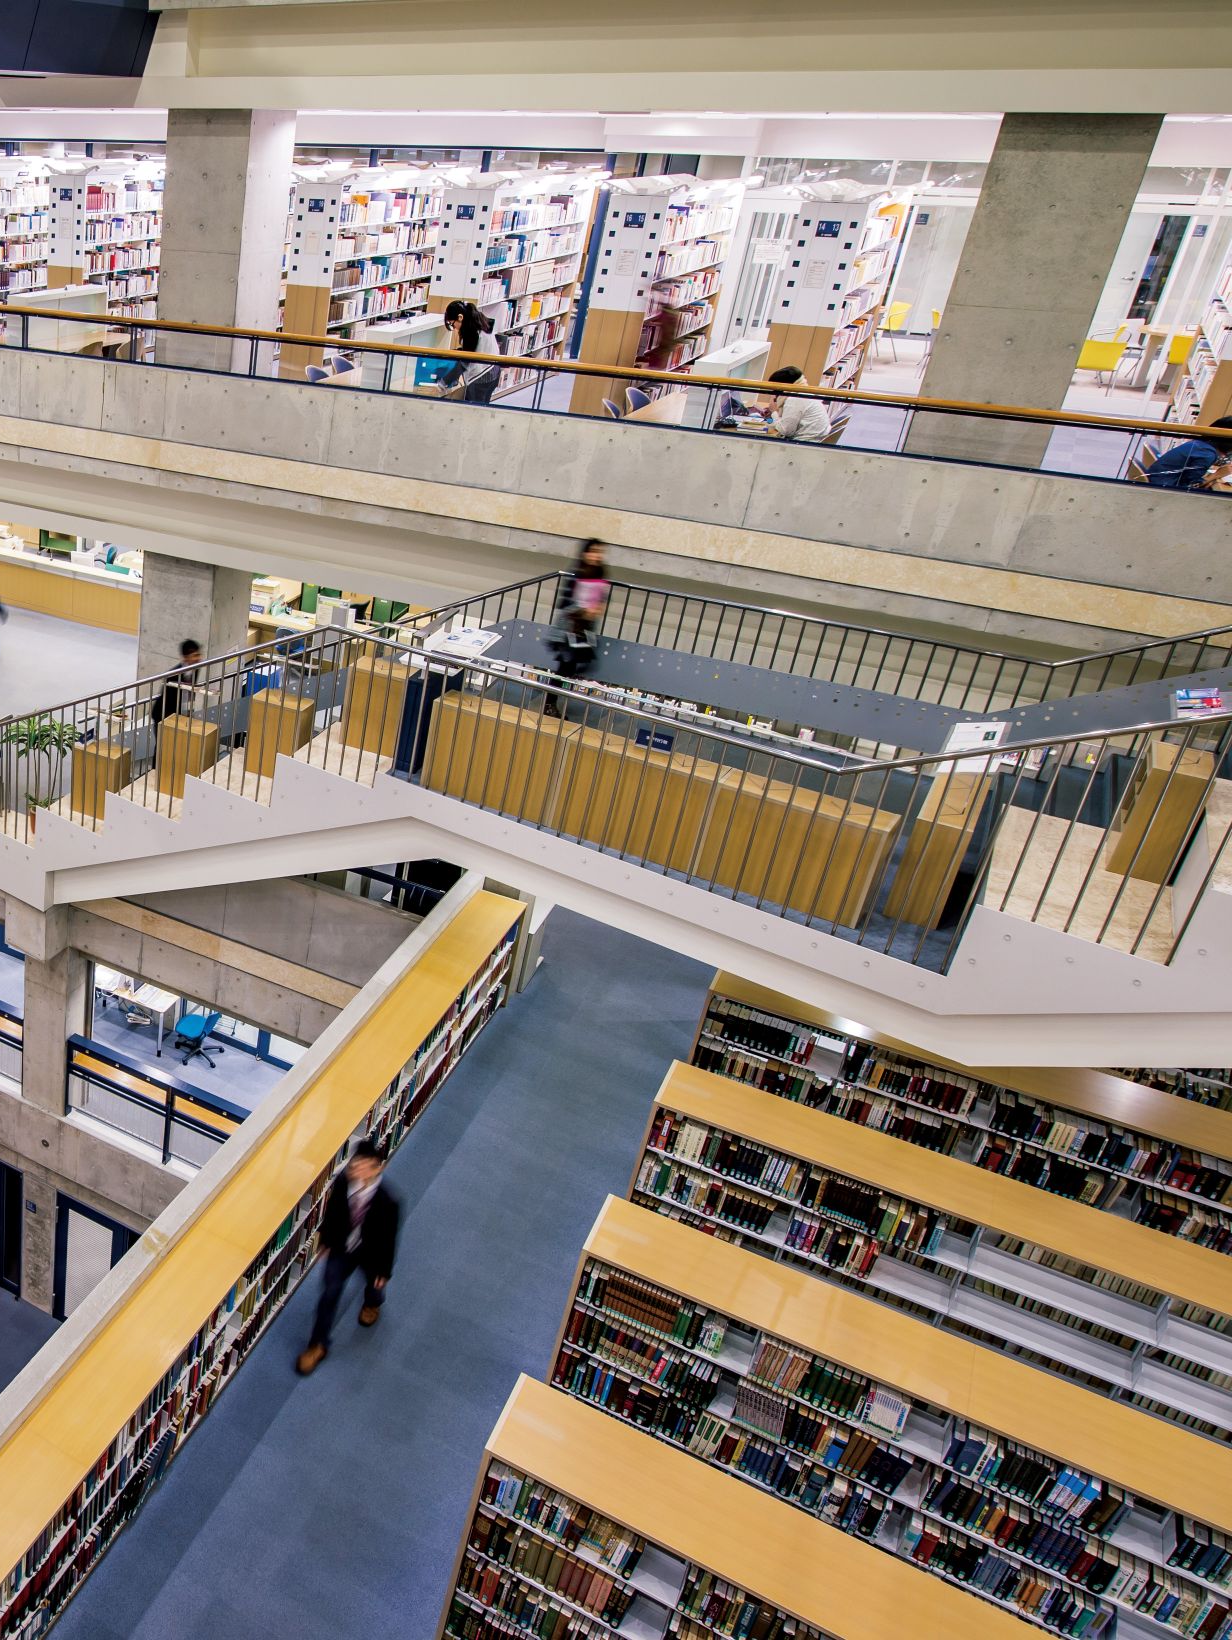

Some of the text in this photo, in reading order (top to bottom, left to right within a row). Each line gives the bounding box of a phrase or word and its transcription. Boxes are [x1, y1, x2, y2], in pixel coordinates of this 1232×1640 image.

[626, 214, 645, 222] 16 15
[819, 223, 840, 231] 14 13
